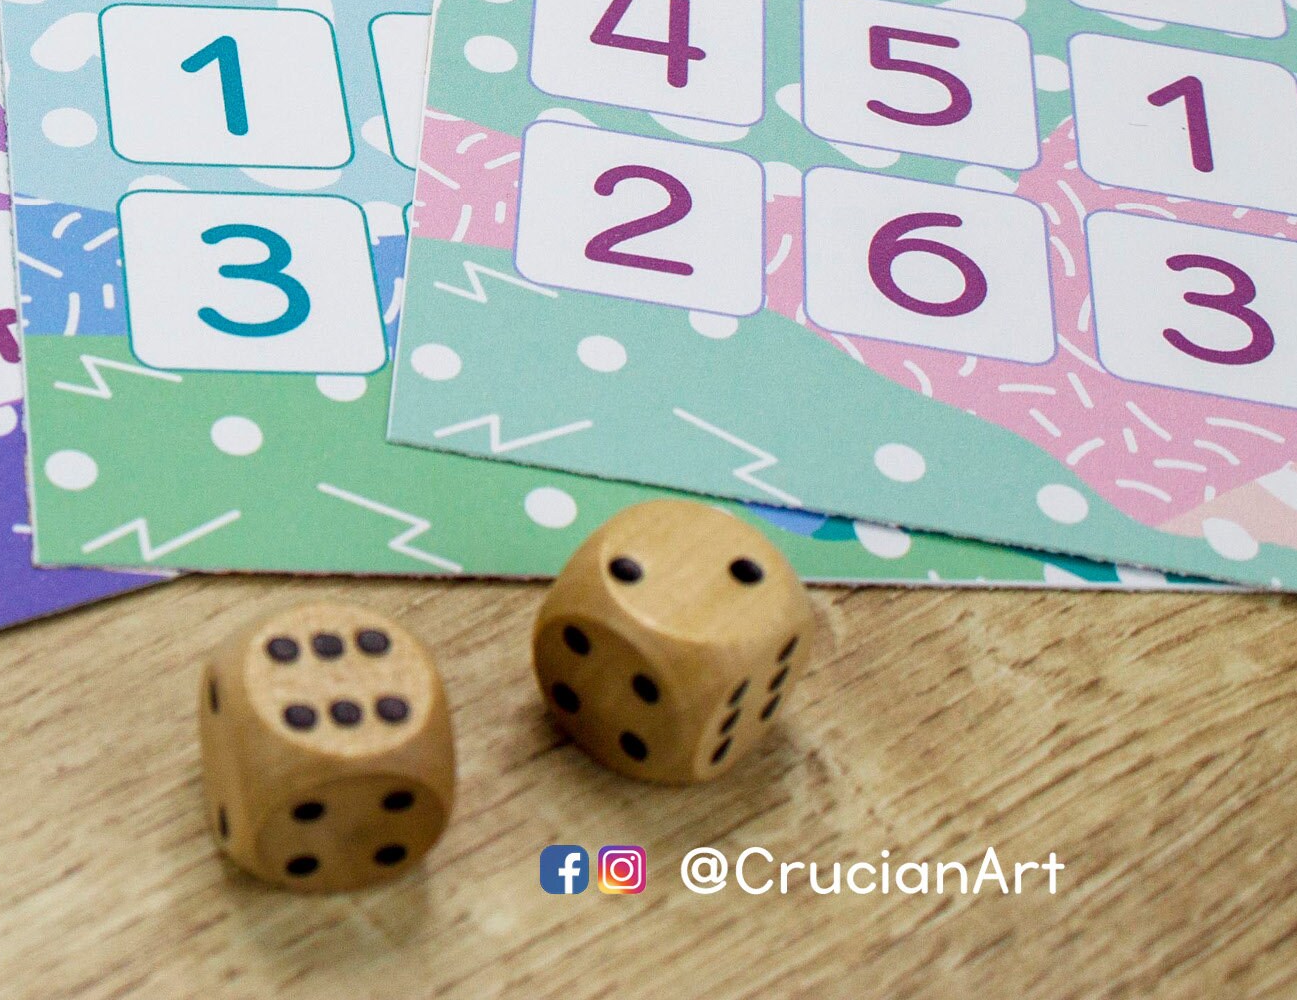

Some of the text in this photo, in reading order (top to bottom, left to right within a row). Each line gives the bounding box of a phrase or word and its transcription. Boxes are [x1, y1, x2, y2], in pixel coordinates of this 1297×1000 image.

[179, 35, 250, 137] 1
[867, 24, 973, 127] 5
[1146, 75, 1215, 173] 1
[197, 223, 312, 339] 3
[584, 164, 1275, 366] 2 6 3
